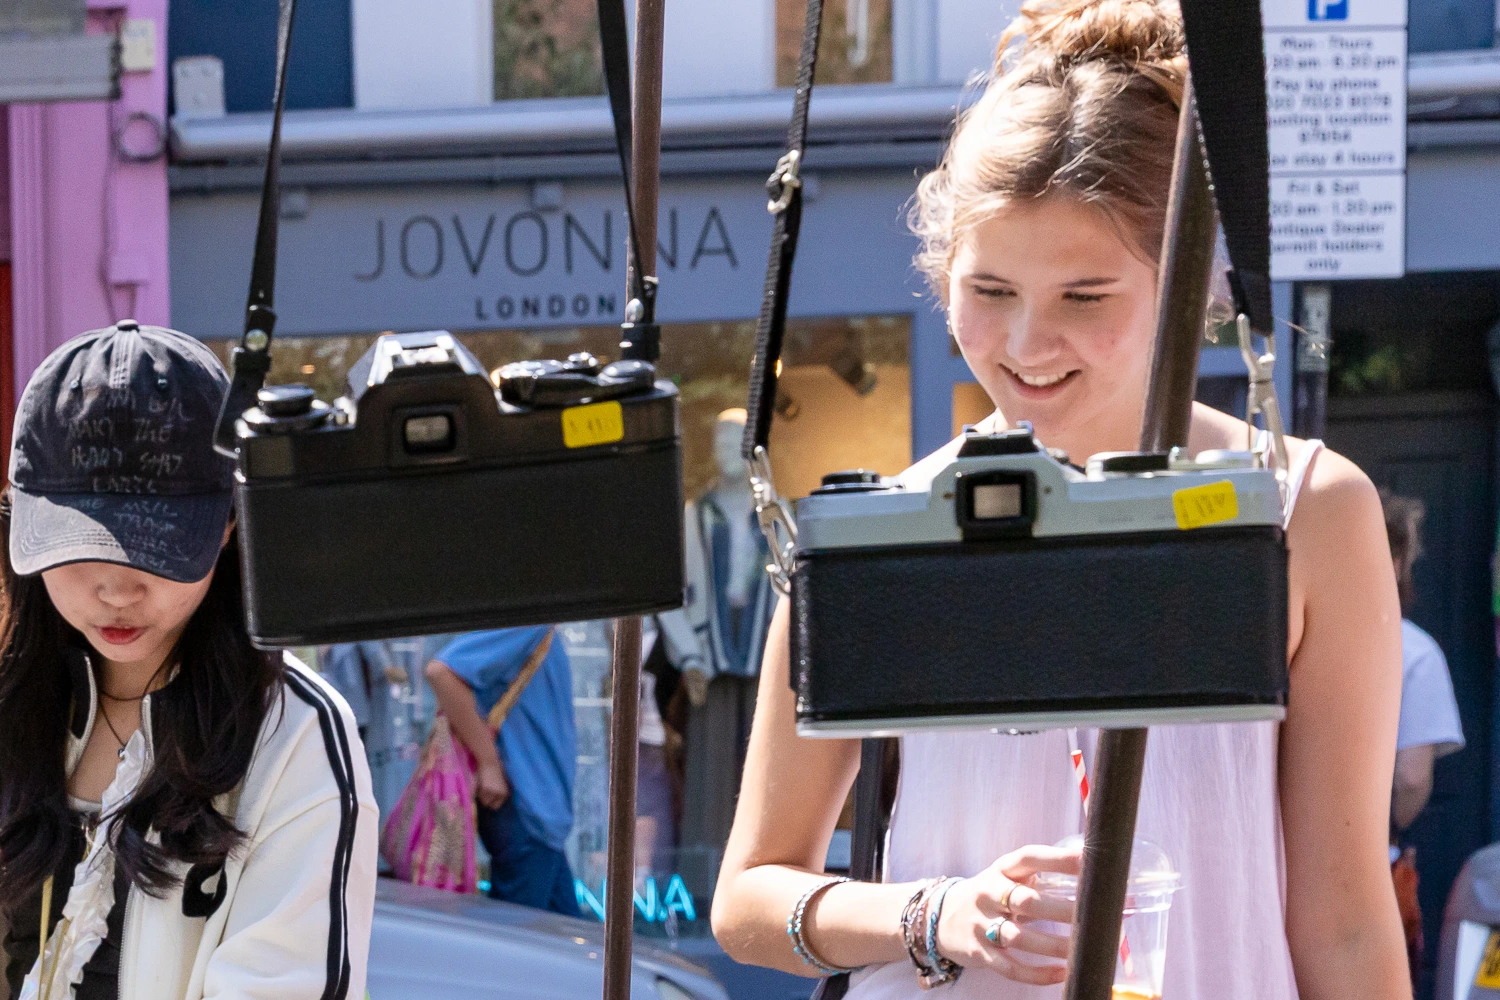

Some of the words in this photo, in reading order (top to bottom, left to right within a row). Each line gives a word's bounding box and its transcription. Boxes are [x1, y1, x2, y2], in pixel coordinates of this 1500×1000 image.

[1270, 113, 1321, 127] uoting
[1271, 222, 1326, 237] ntique
[1271, 240, 1318, 252] ermit
[475, 294, 618, 321] LONDON
